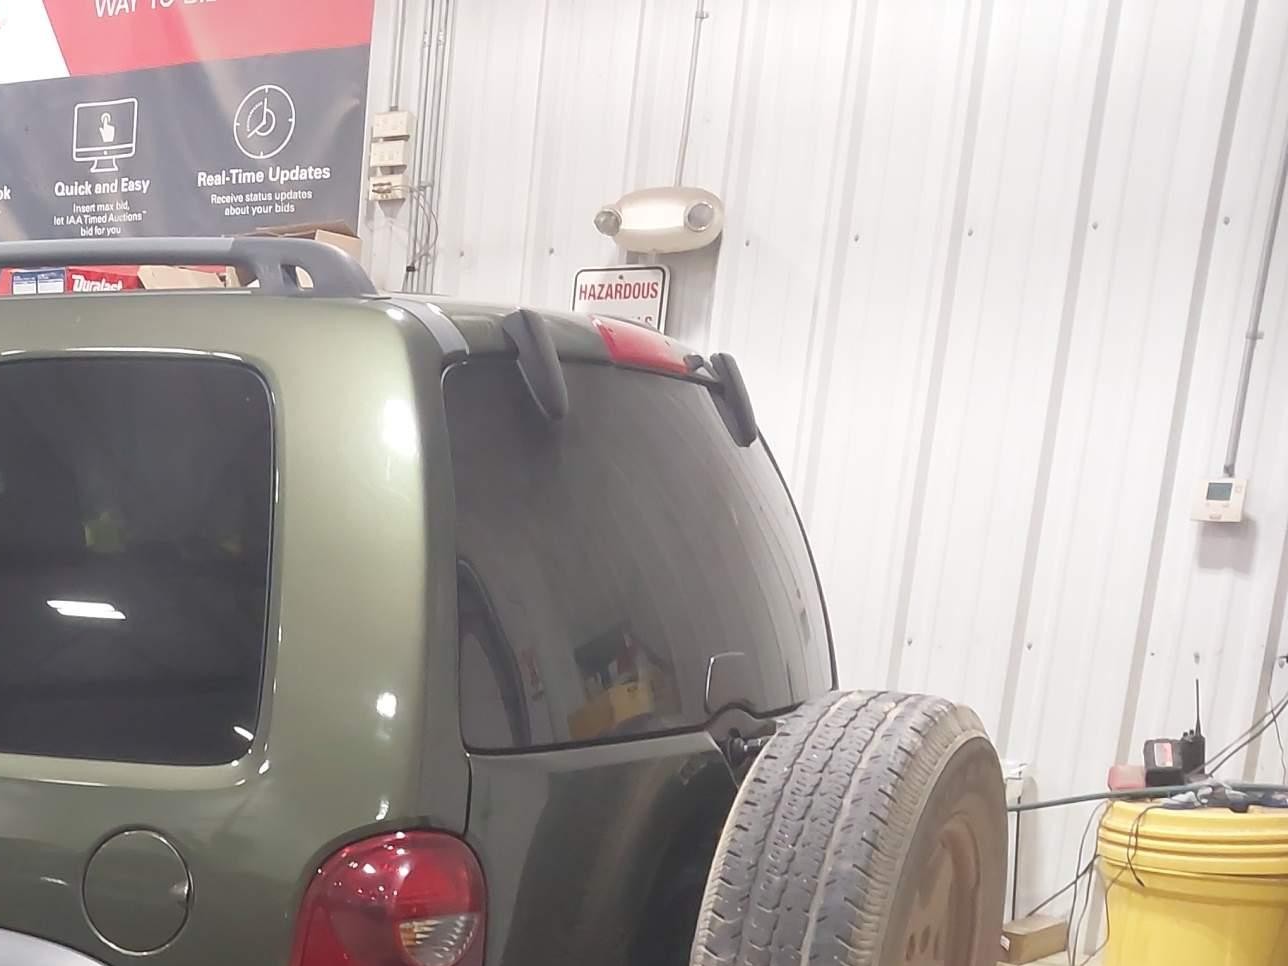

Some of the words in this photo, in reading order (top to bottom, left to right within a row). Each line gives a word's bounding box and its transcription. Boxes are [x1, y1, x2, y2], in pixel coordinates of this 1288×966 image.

[197, 168, 264, 187] Real-Time
[268, 165, 331, 184] Updates
[54, 181, 92, 196] Quick
[94, 179, 118, 194] and
[121, 177, 151, 194] Easy
[210, 192, 243, 204] Receive
[245, 191, 273, 202] status
[274, 189, 313, 203] updates
[73, 202, 95, 214] Insert
[97, 203, 114, 213] max
[224, 204, 250, 216] about
[251, 204, 273, 217] your
[275, 203, 295, 214] bids
[66, 215, 83, 225] IAA
[83, 213, 108, 225] Timed
[80, 226, 93, 237] bid
[94, 225, 106, 236] for
[106, 226, 121, 236] you
[579, 281, 659, 300] HAZARDOUS
